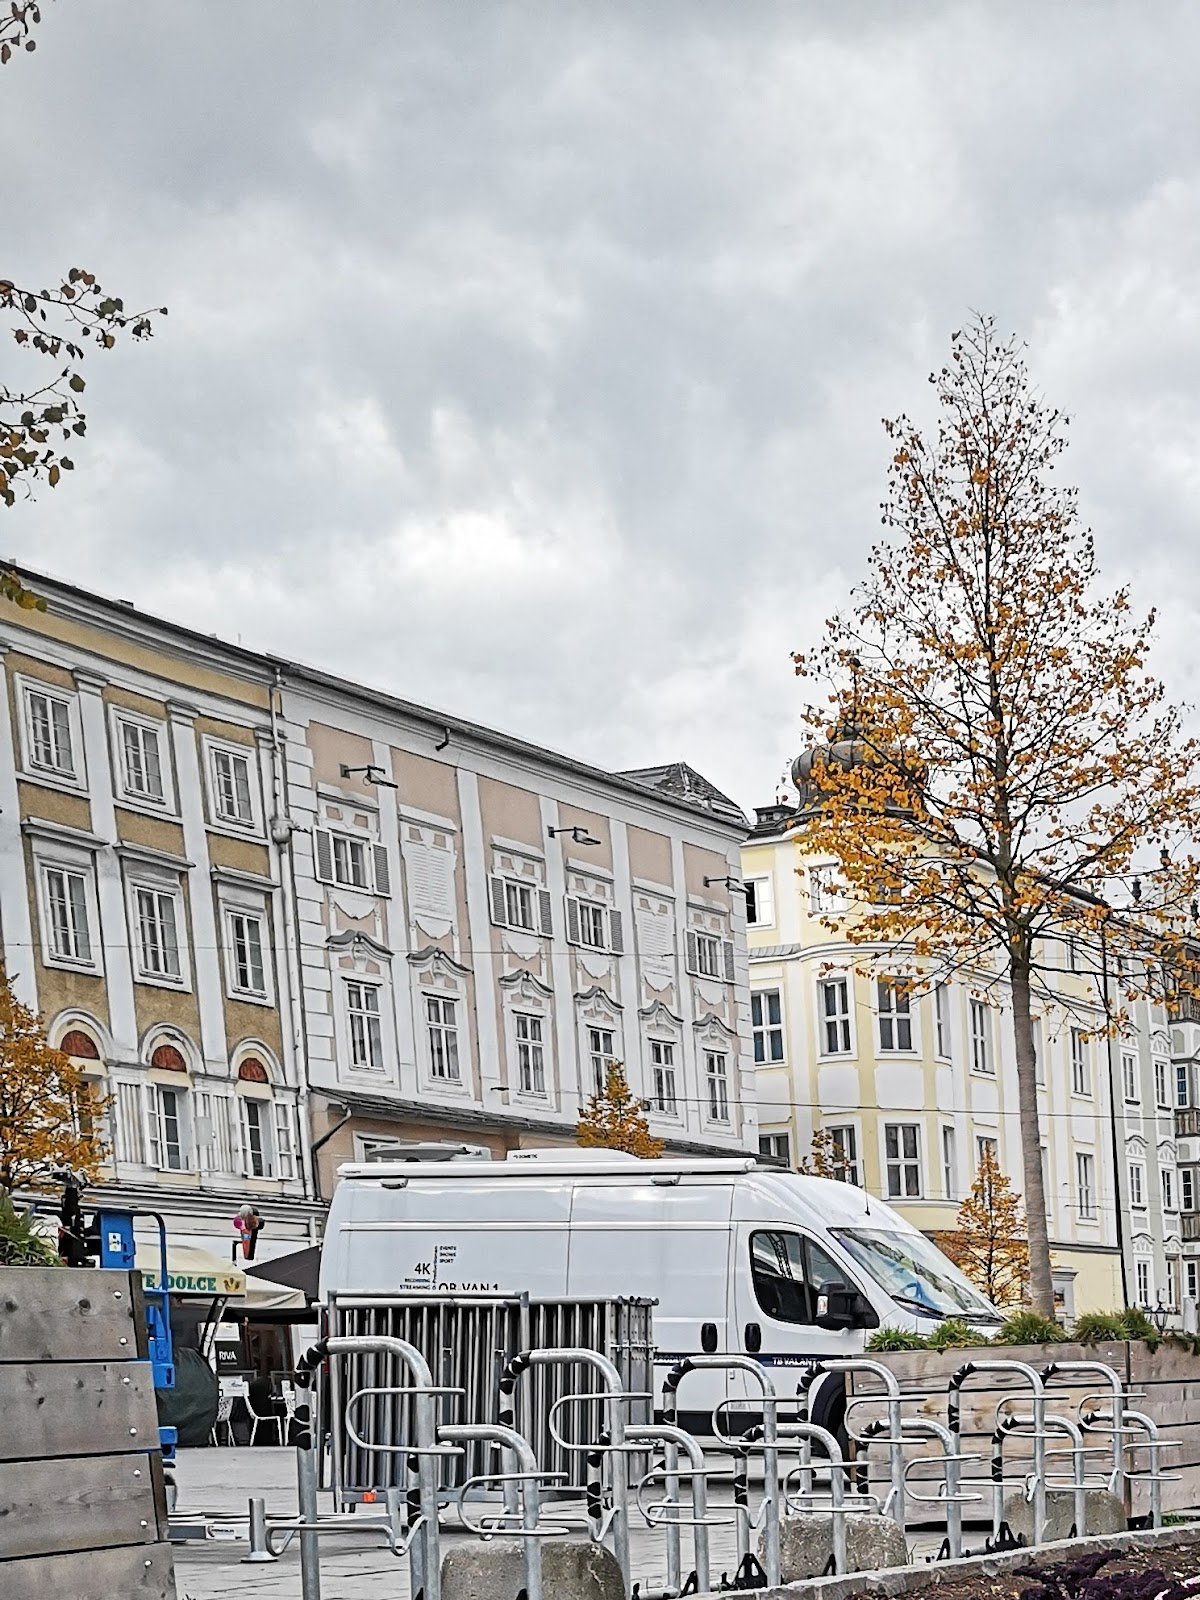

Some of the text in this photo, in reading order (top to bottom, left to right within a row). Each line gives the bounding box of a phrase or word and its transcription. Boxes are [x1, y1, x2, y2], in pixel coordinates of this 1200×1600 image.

[414, 1262, 431, 1275] 4K
[167, 1276, 217, 1291] DOLCE
[219, 1351, 237, 1360] RIVA
